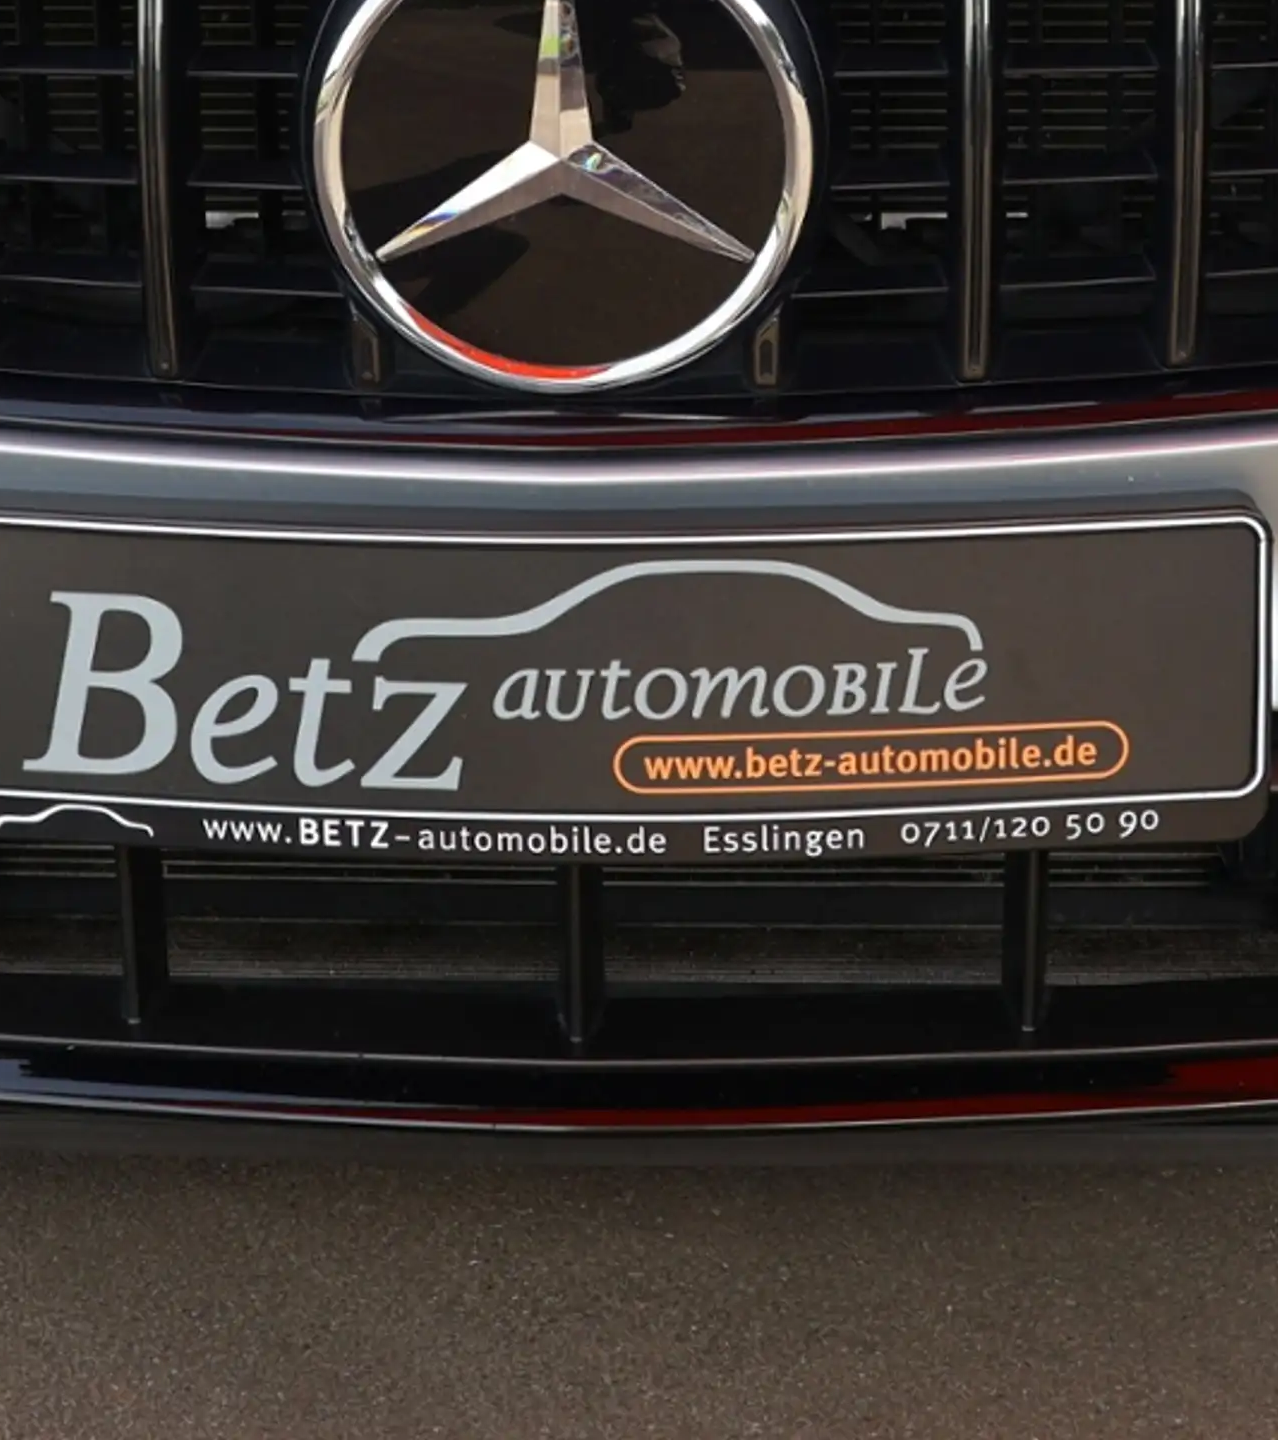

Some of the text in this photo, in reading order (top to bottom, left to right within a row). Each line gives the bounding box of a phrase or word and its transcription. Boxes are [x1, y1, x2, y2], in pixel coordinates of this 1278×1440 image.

[22, 590, 468, 791] Betz
[643, 734, 1098, 780] www.betz-automobile.de
[202, 808, 1160, 857] www.BETZ-automobile.de Esslingen 0711/120 50 90
